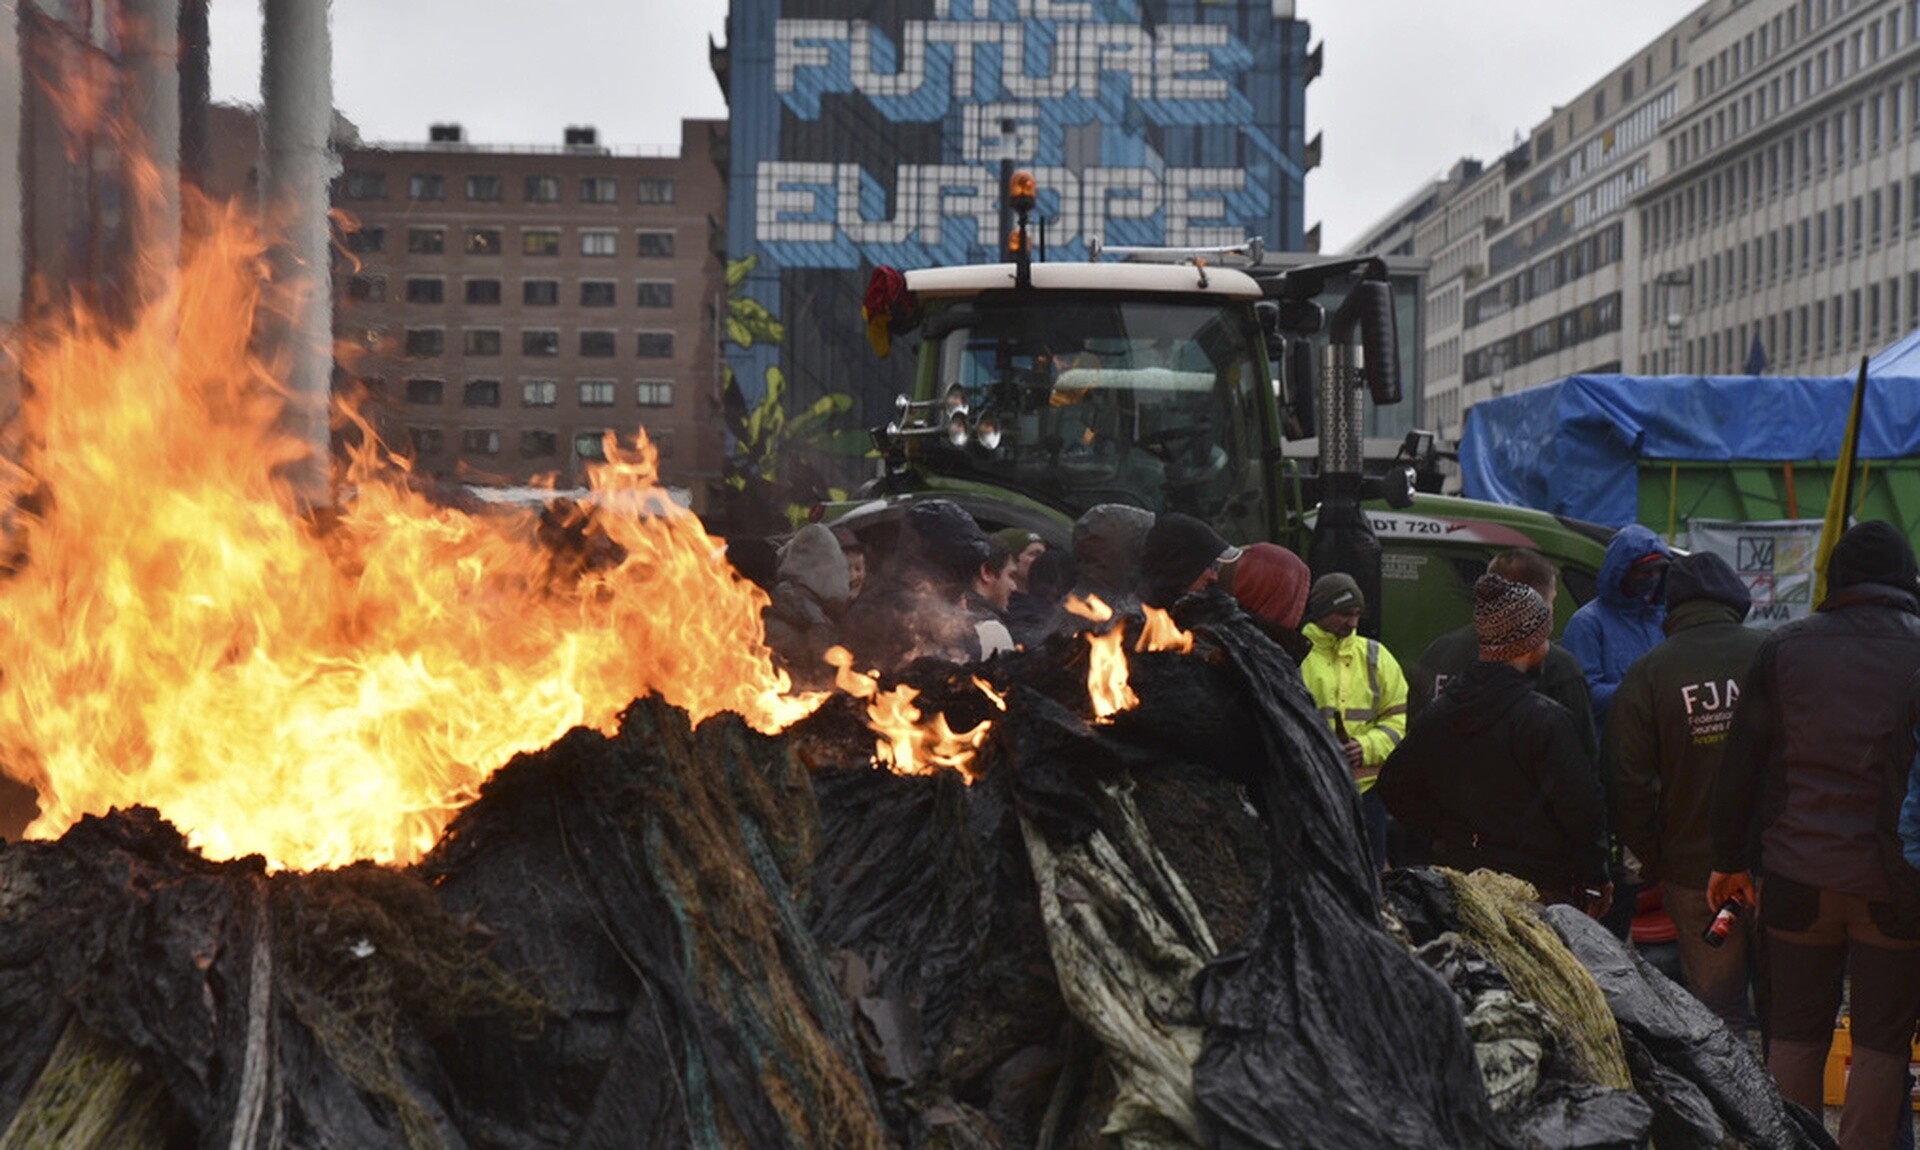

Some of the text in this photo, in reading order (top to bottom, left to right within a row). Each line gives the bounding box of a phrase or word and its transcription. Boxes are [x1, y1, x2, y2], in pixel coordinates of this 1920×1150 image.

[774, 19, 1229, 98] FUTURE
[962, 102, 1039, 162] IS
[756, 161, 1246, 247] EUROPE
[1368, 519, 1397, 532] DT
[1405, 521, 1441, 534] 720
